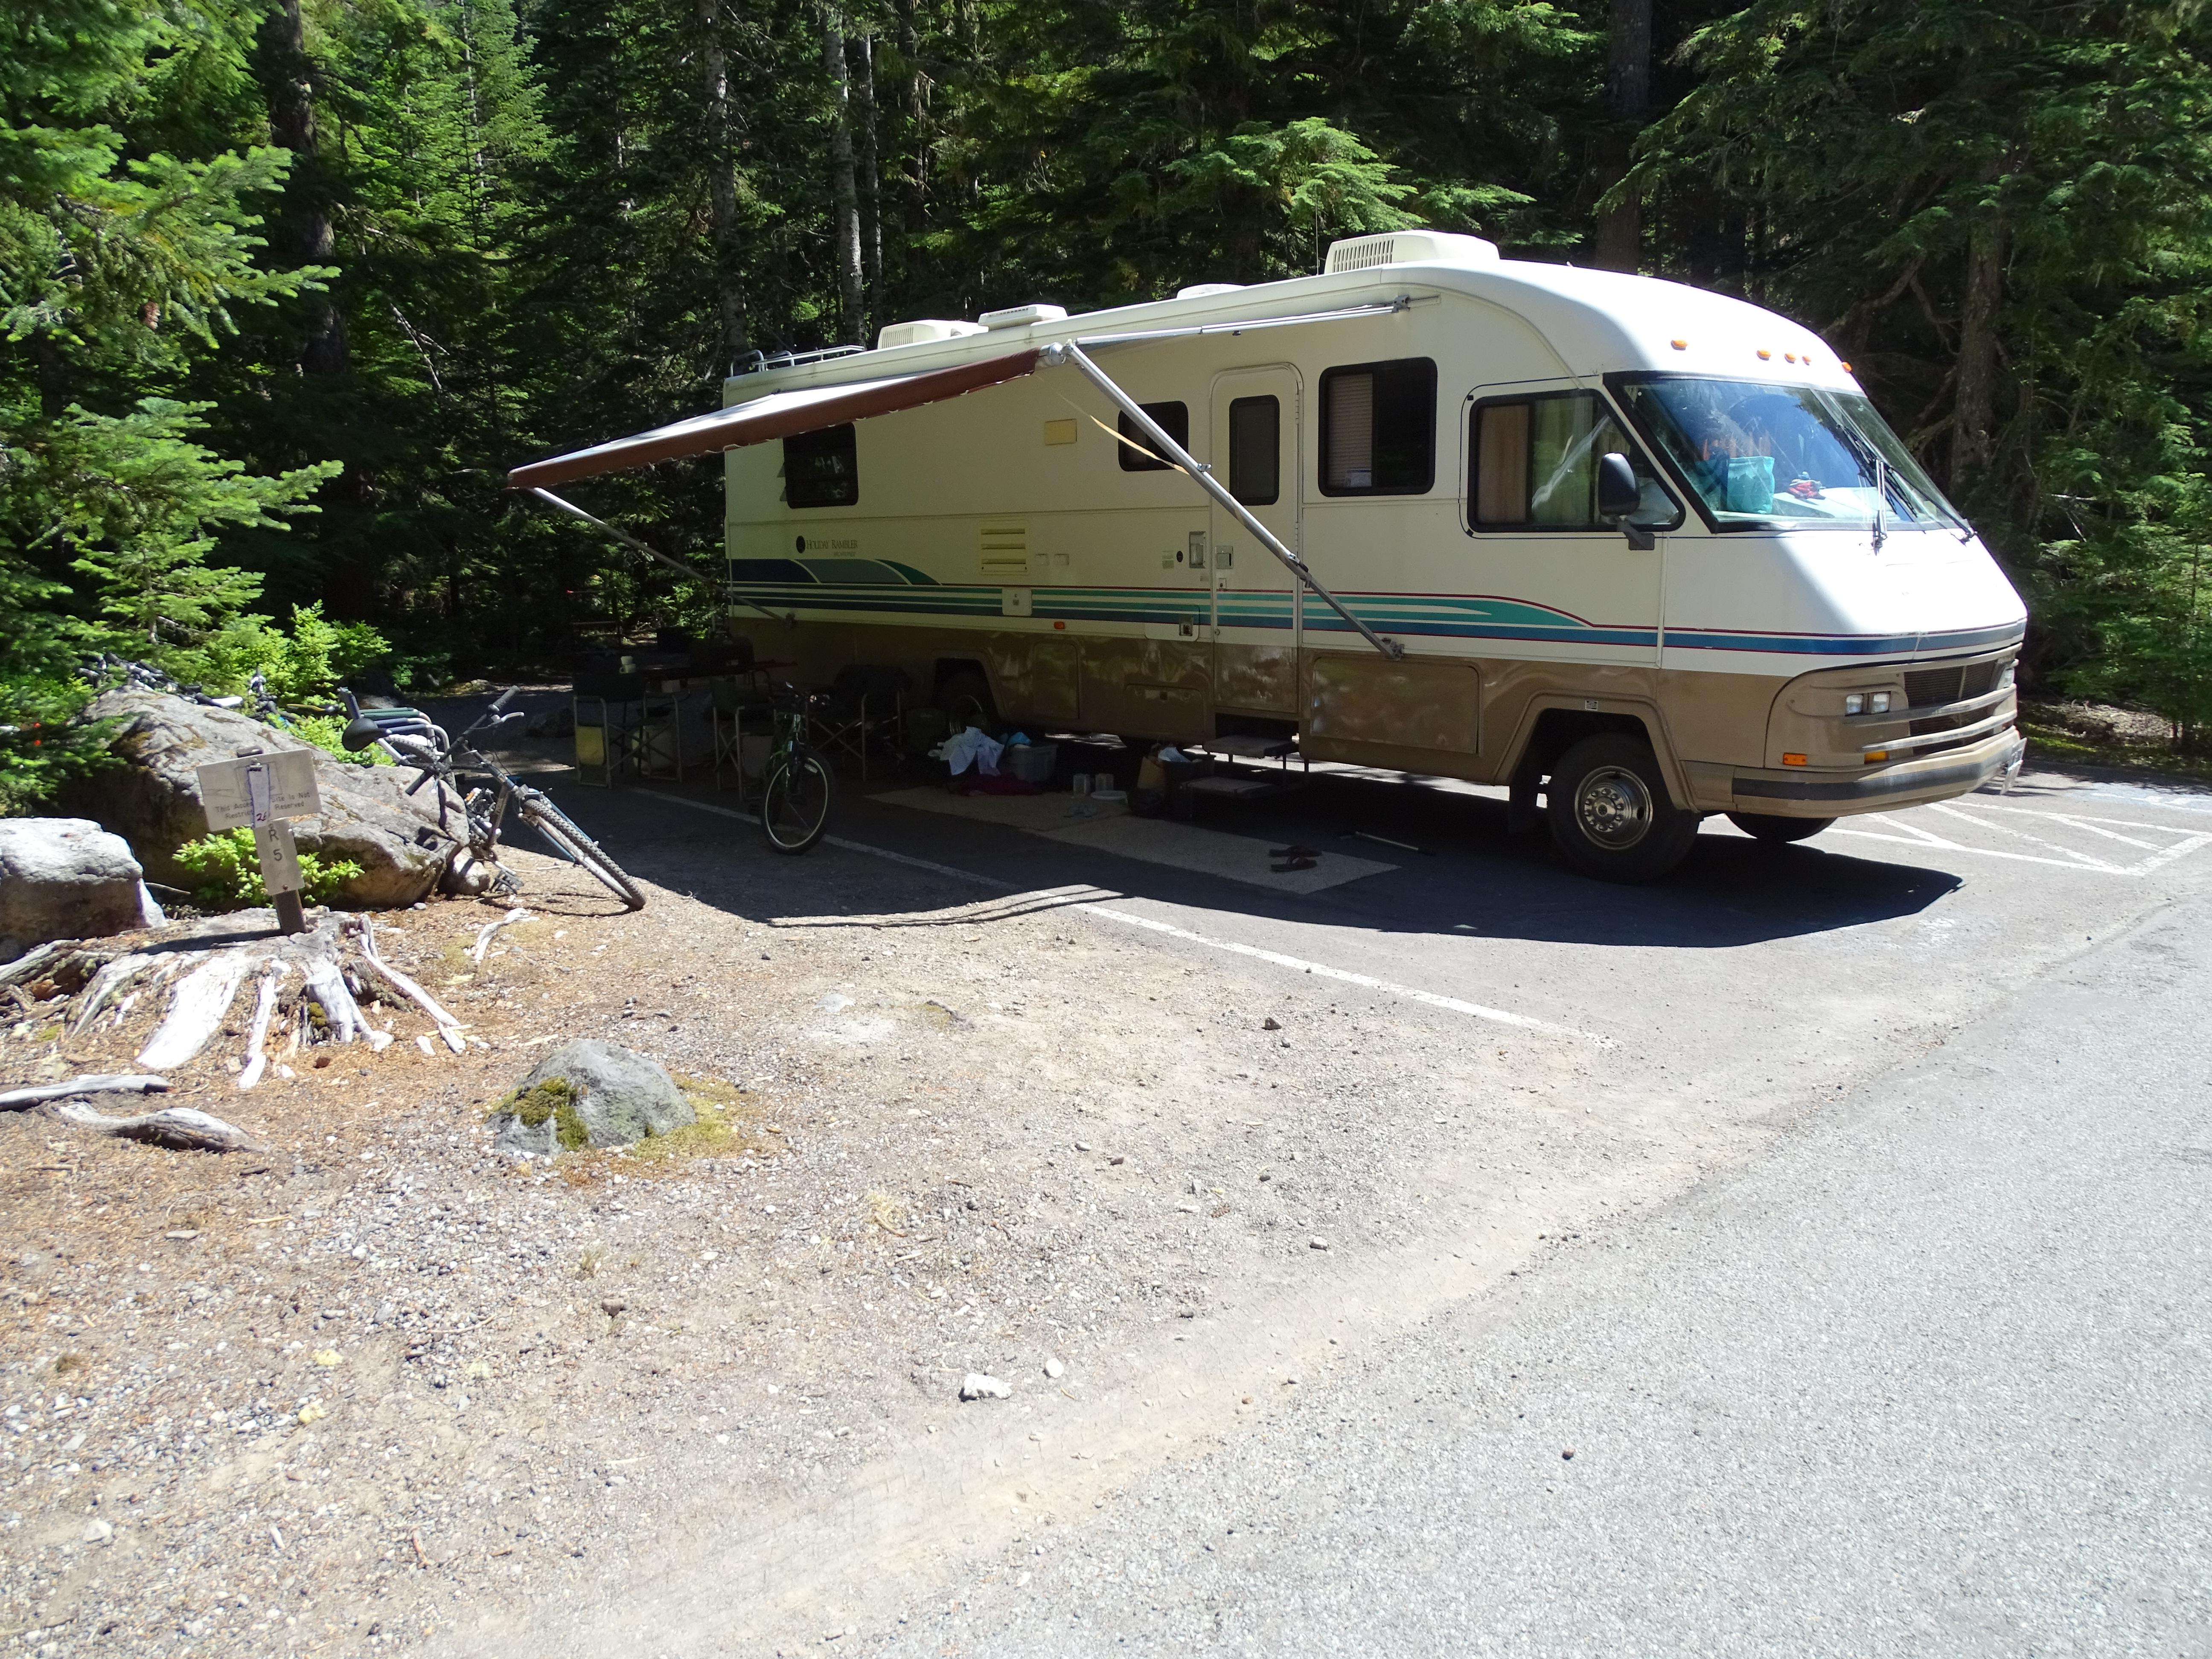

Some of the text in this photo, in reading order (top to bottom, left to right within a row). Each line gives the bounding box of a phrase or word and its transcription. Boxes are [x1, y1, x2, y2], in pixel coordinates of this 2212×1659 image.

[831, 539, 858, 549] RAMBLER
[274, 801, 304, 810] Reserved
[269, 829, 279, 842] R
[273, 848, 283, 861] 5
